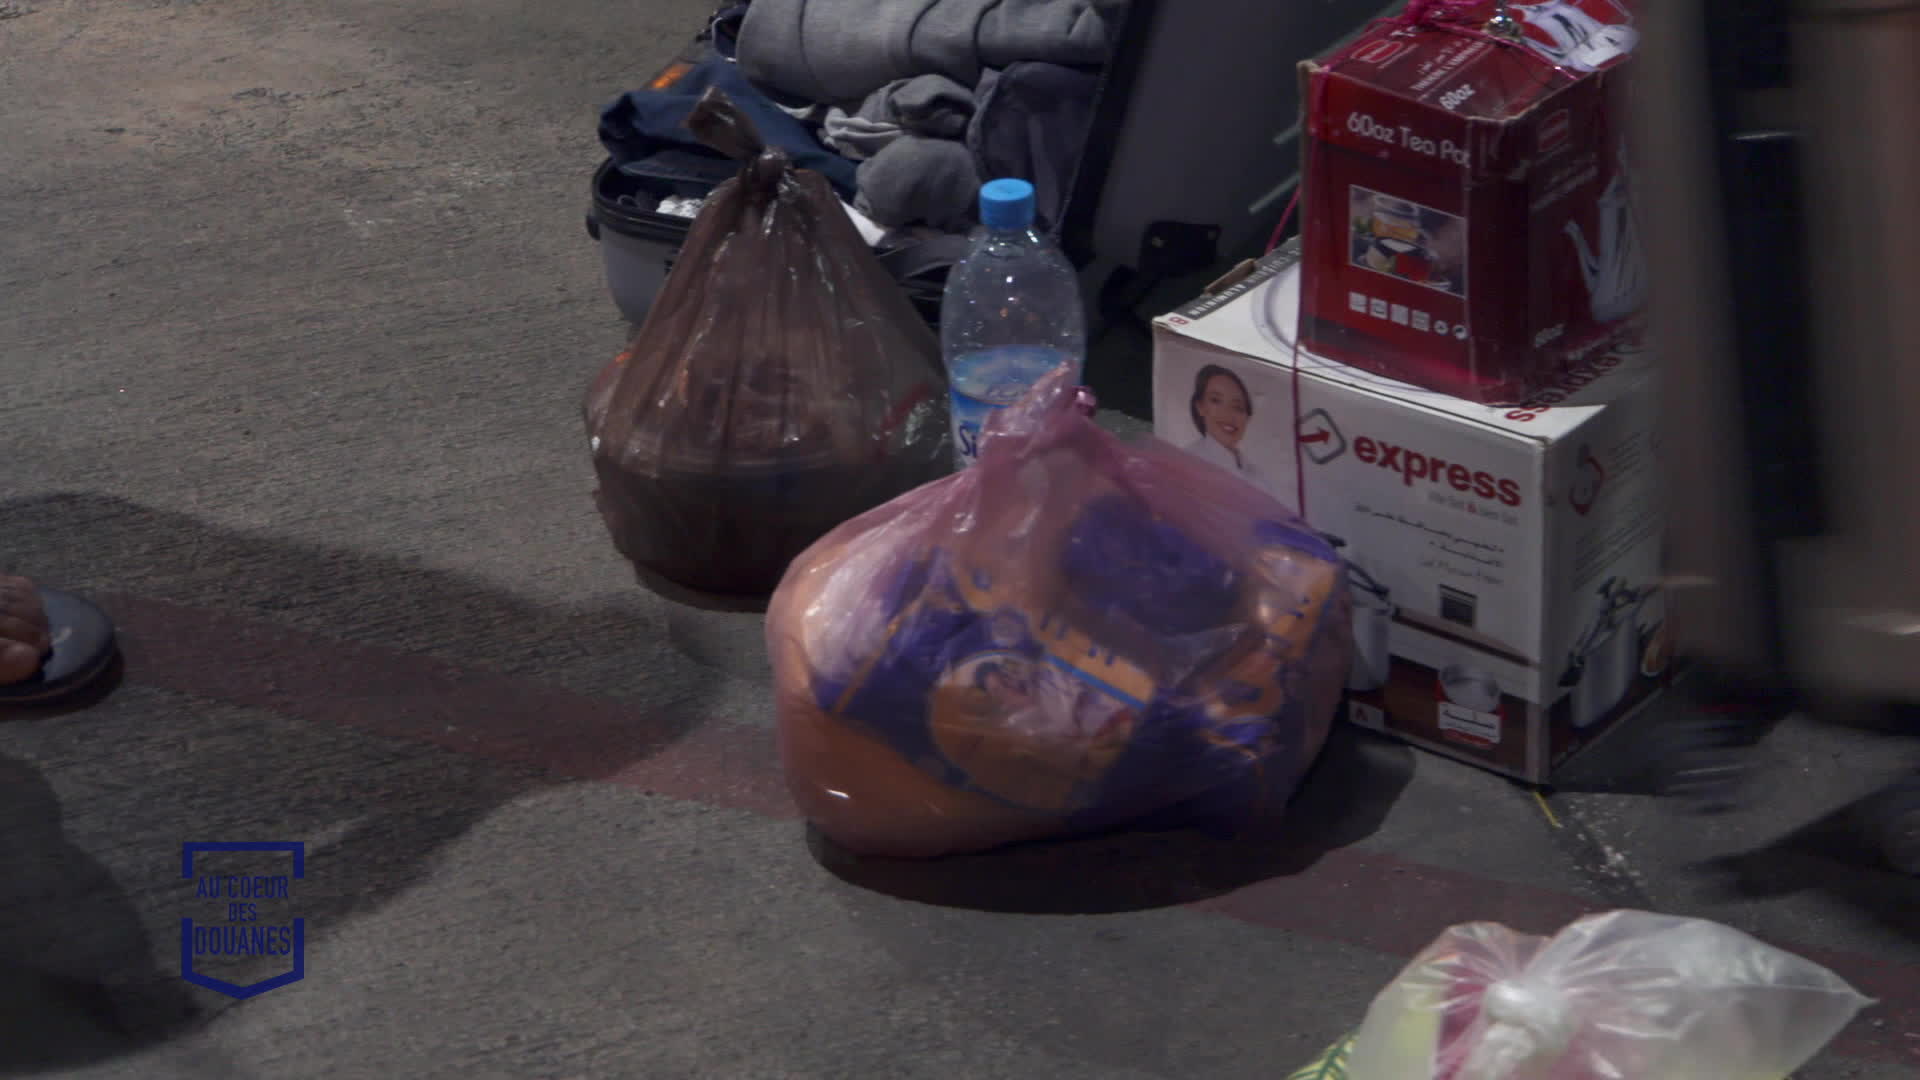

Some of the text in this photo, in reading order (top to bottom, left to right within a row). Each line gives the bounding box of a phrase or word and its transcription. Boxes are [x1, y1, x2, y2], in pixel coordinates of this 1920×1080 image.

[1346, 111, 1394, 144] 60oz
[1399, 126, 1435, 156] Tea
[1353, 436, 1521, 507] express
